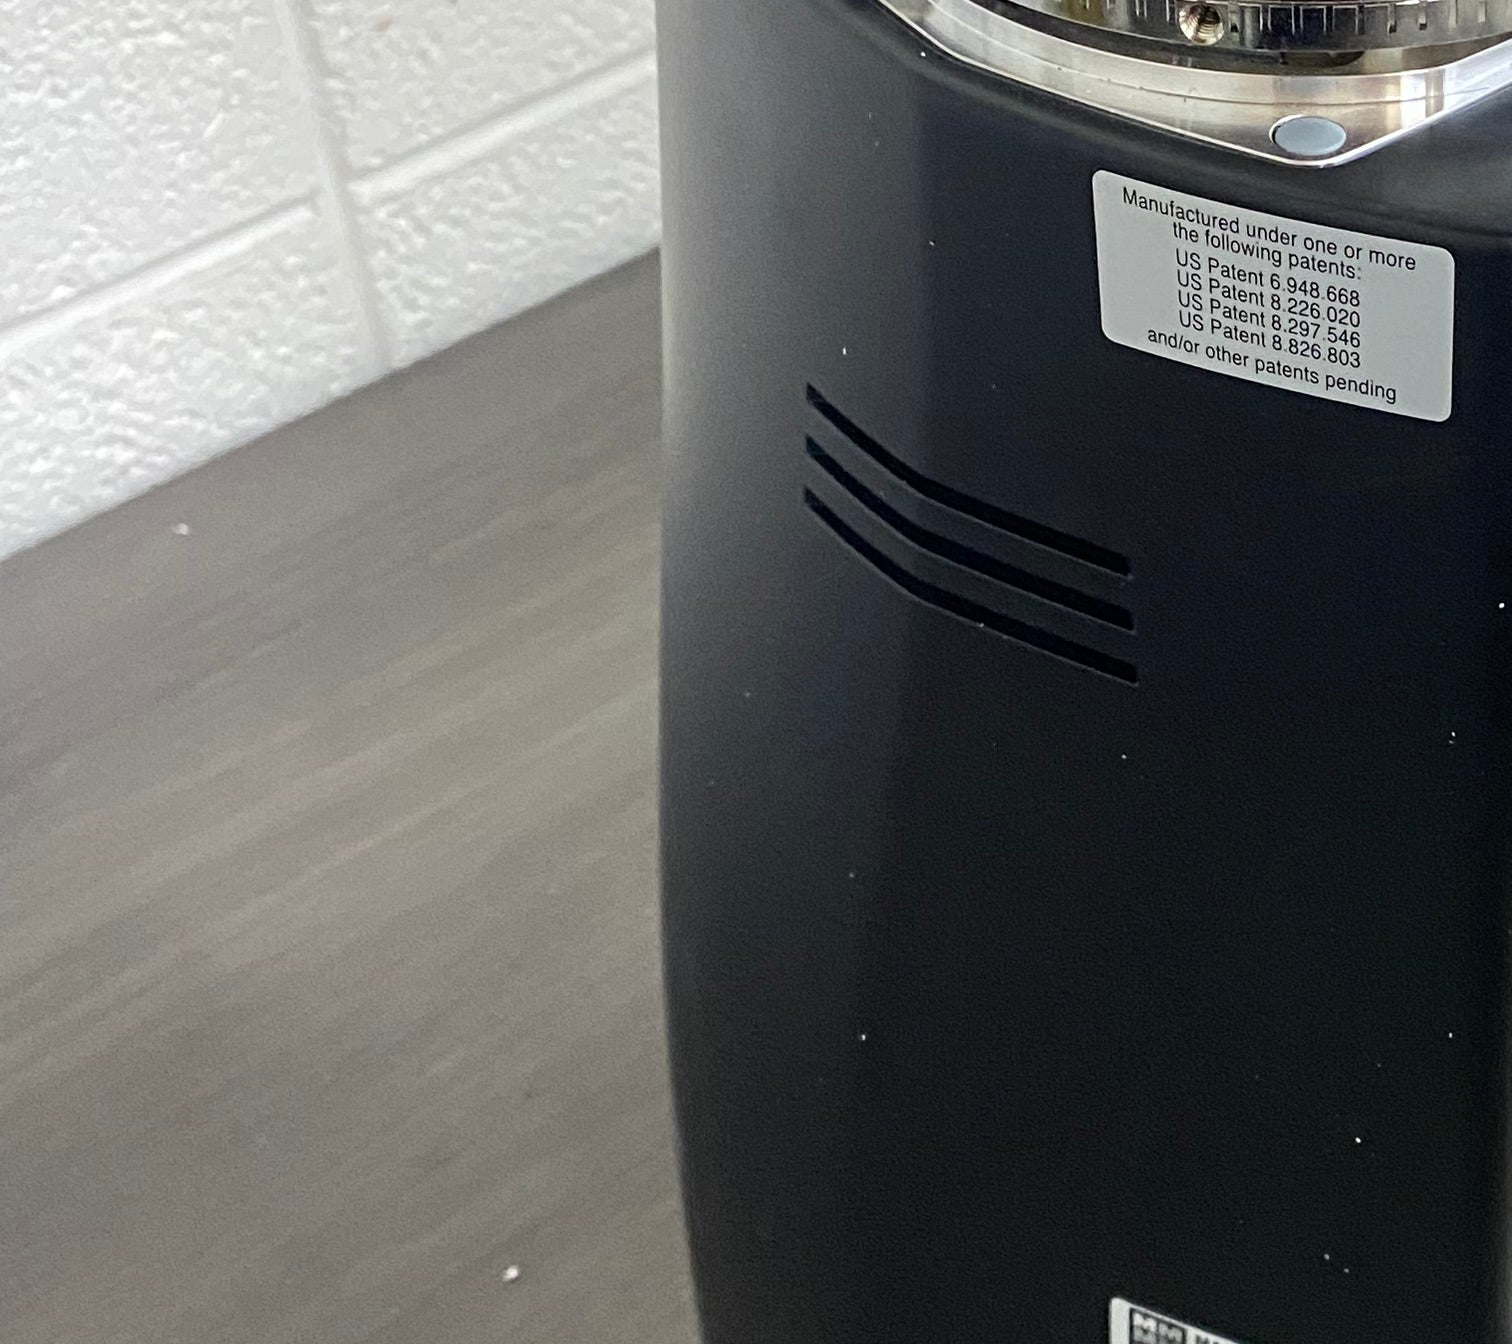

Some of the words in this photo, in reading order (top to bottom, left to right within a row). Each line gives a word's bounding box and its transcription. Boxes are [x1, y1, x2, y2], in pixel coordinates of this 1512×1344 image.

[1122, 186, 1240, 234] Manufactured
[1246, 221, 1297, 248] under
[1303, 235, 1337, 255] one
[1344, 244, 1362, 259] or
[1369, 248, 1416, 271] more
[1173, 222, 1199, 245] the
[1204, 229, 1282, 267] following
[1288, 251, 1362, 280] patents:
[1176, 249, 1200, 271] US
[1208, 258, 1264, 287] Patent
[1270, 273, 1360, 307] 6.948.668
[1177, 269, 1201, 291] US
[1210, 279, 1264, 308] Patent
[1270, 294, 1361, 327] 8.226.020
[1178, 290, 1202, 312] US
[1211, 299, 1265, 329] Patent
[1271, 314, 1361, 348] 8.297.546
[1179, 311, 1204, 332] US
[1212, 320, 1266, 349] Patent
[1272, 335, 1361, 368] 8.826.803
[1148, 327, 1199, 354] and/or
[1205, 343, 1249, 368] other
[1256, 358, 1319, 384] patents
[1325, 376, 1397, 404] pending
